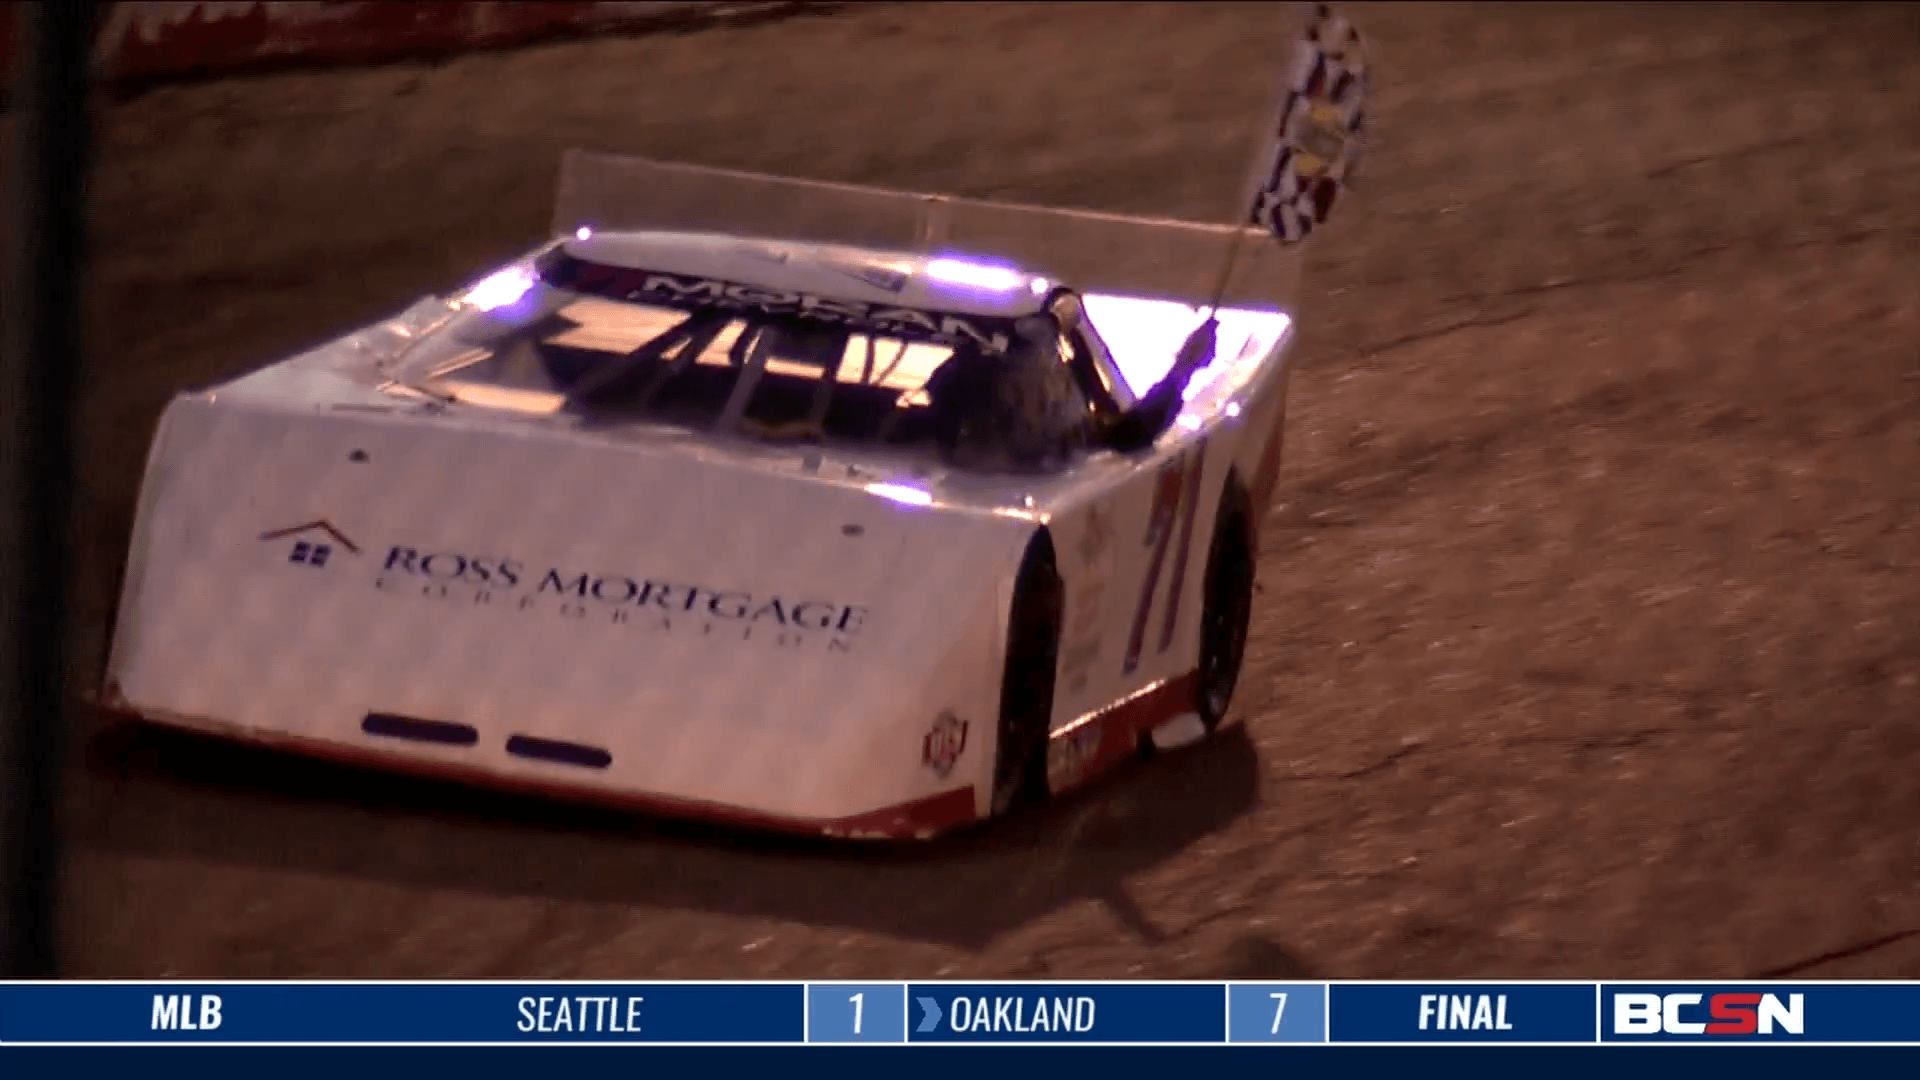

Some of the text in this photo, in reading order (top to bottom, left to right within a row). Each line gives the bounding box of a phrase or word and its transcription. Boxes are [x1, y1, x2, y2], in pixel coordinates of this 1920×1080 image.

[643, 274, 1010, 355] MORAN
[383, 544, 869, 635] ROSS MORTGAGE
